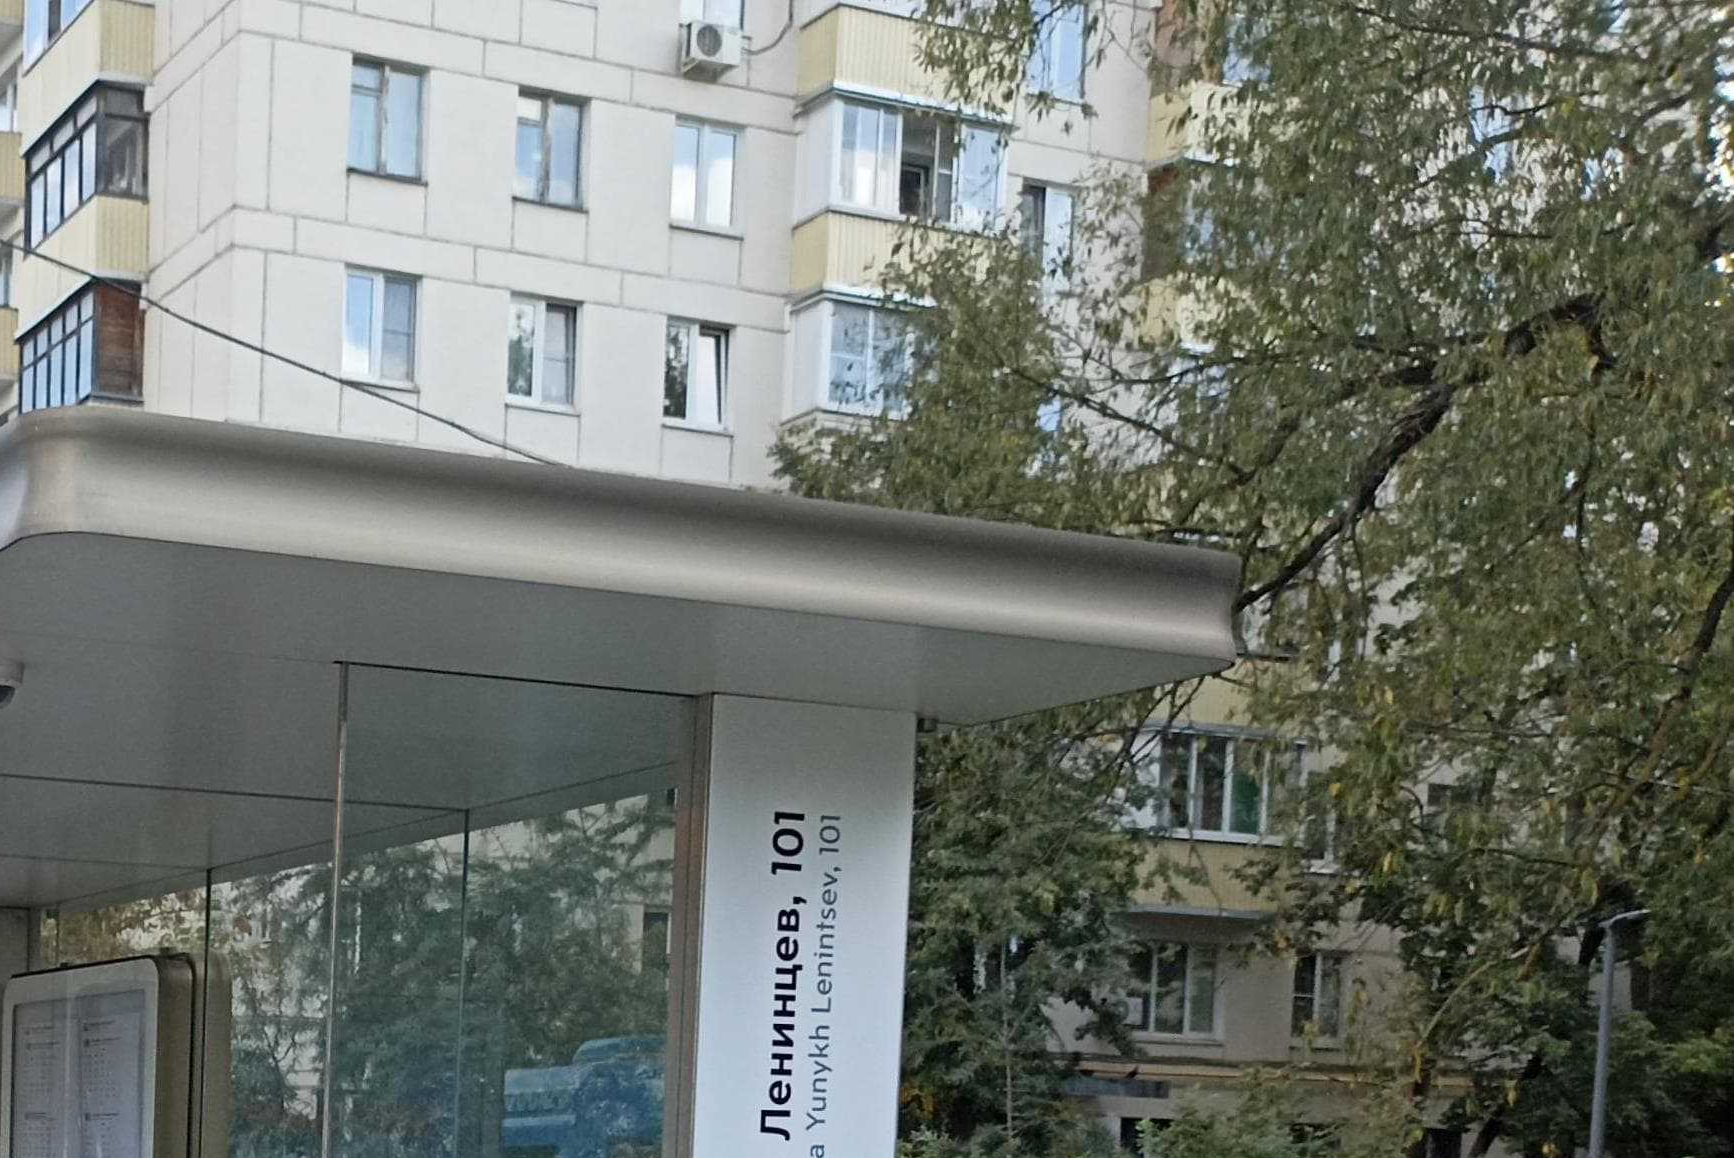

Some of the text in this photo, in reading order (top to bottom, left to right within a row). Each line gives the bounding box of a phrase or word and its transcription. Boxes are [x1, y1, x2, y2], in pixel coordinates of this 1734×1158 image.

[771, 810, 806, 875] 101
[819, 813, 842, 855] 101
[811, 865, 842, 1014] Lenintsev,
[760, 895, 807, 1140] Ленинцев,
[805, 1023, 834, 1131] Yunykh
